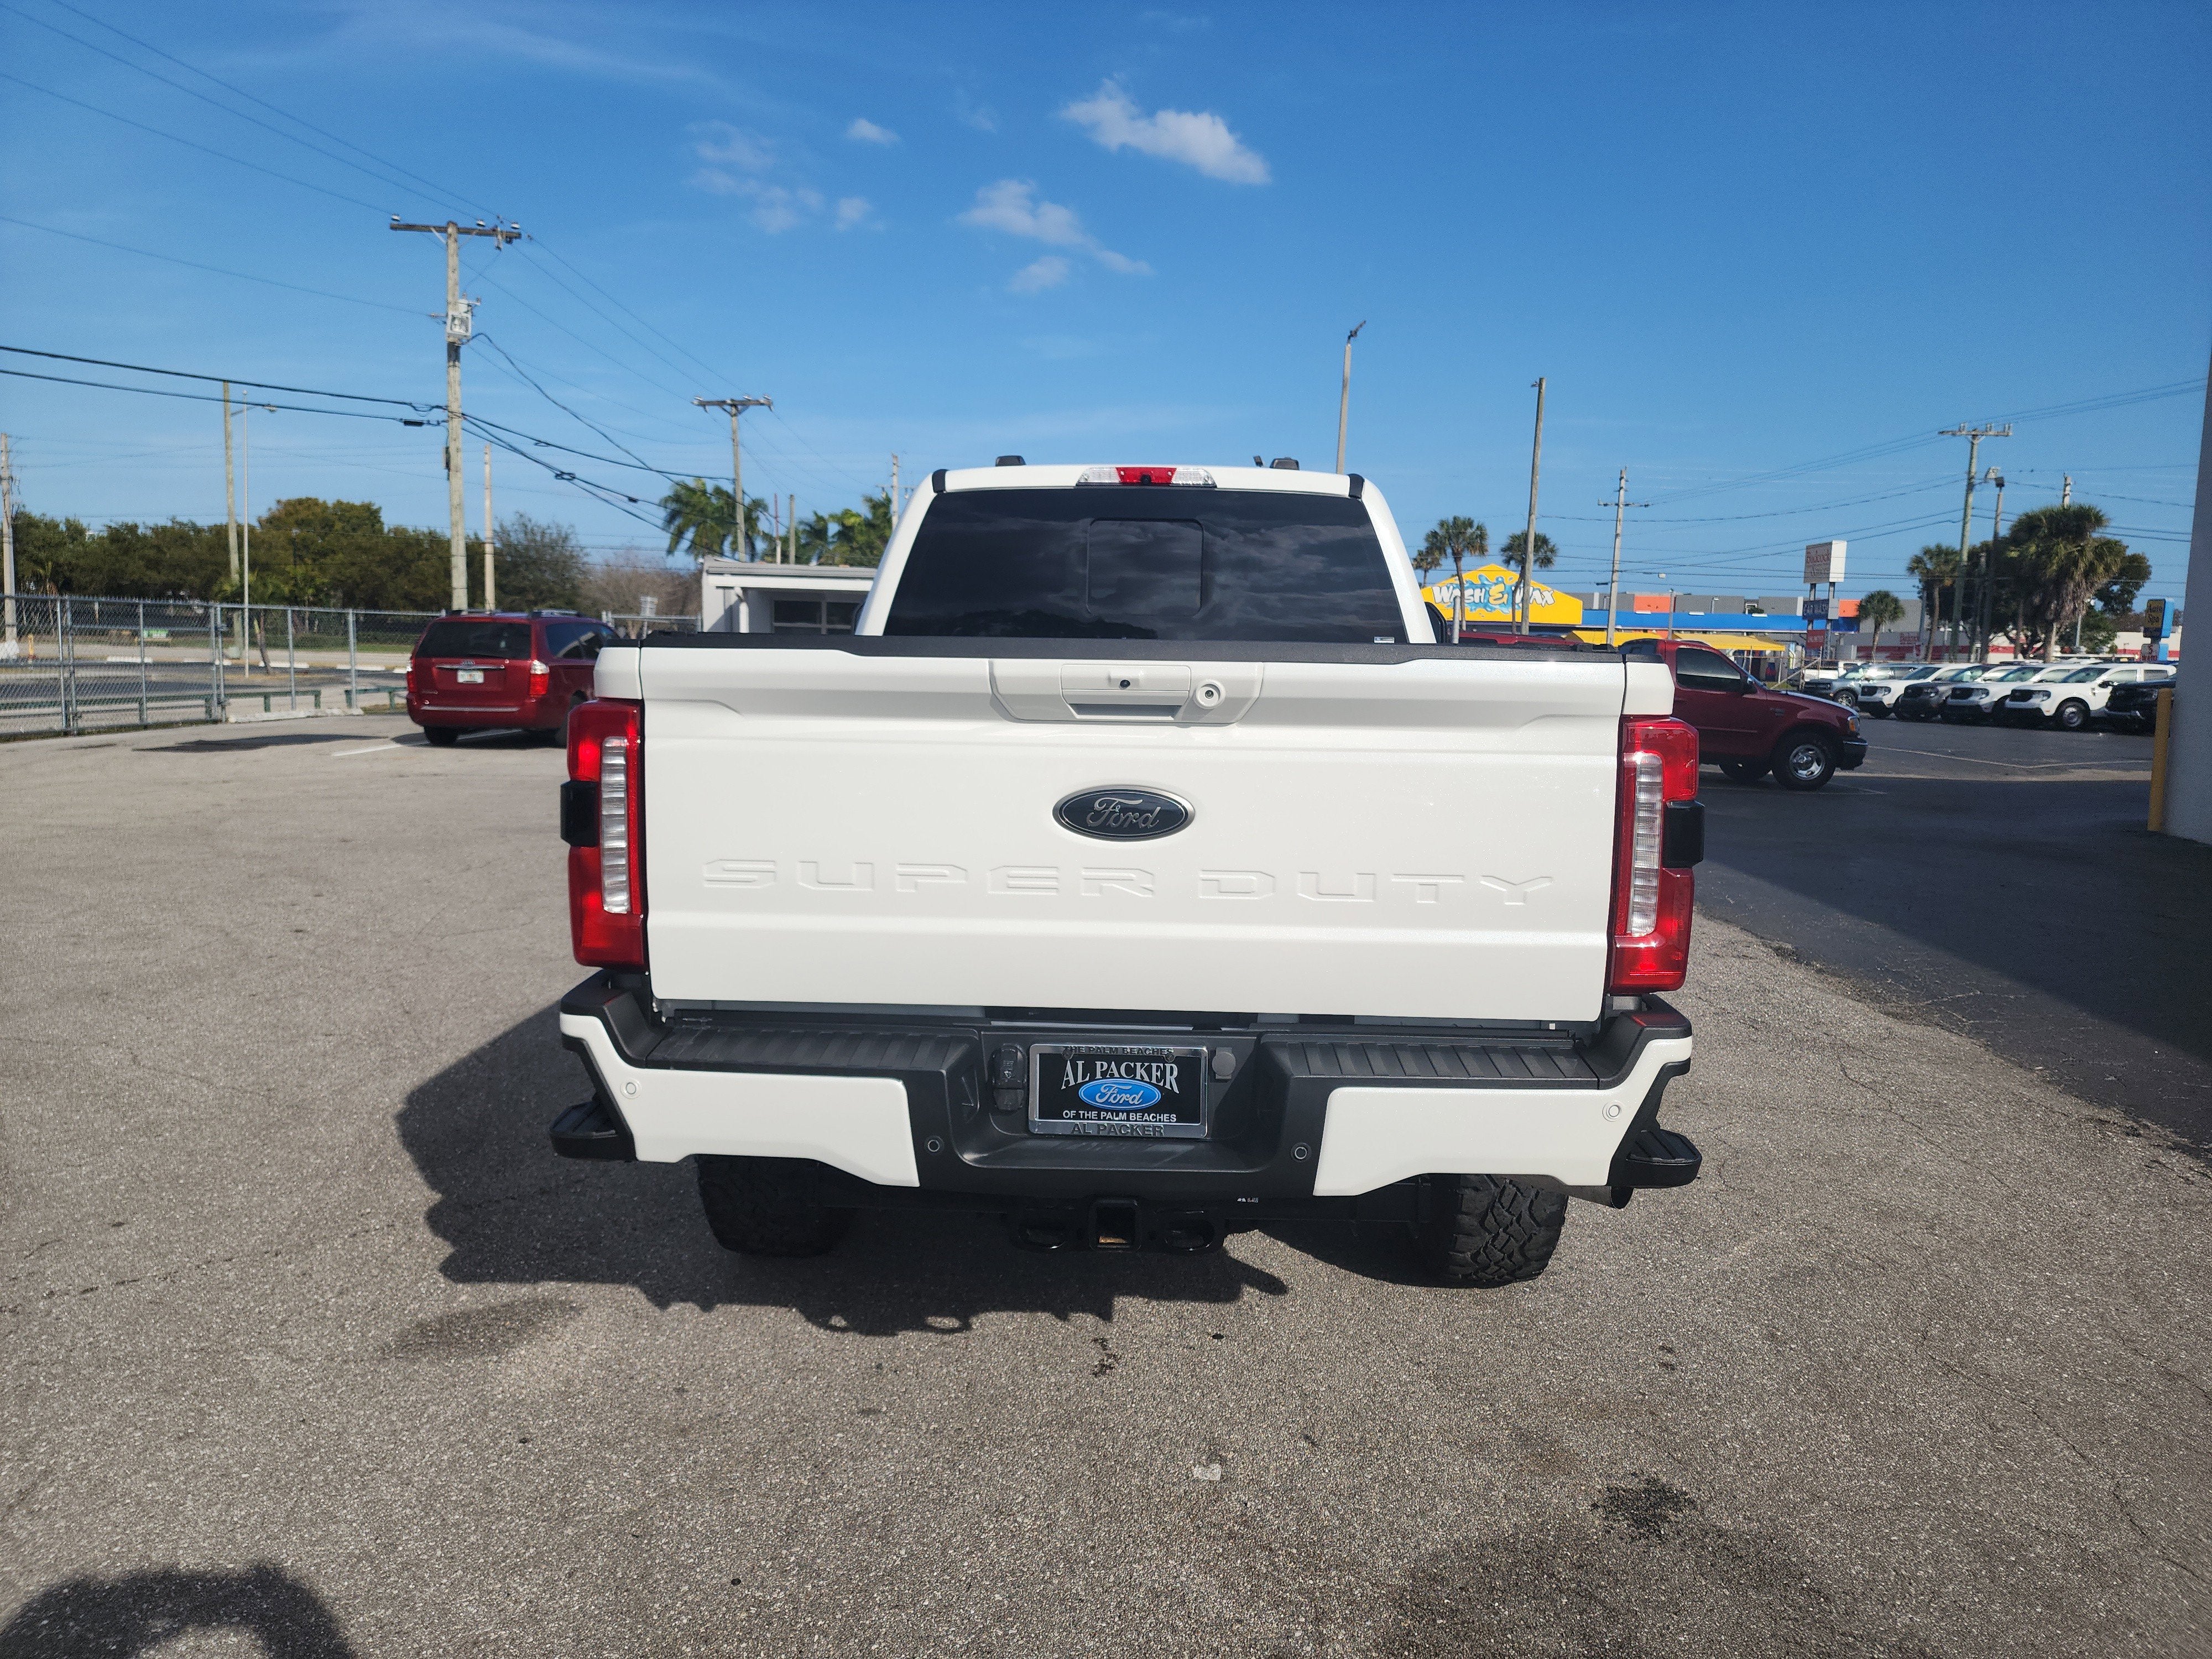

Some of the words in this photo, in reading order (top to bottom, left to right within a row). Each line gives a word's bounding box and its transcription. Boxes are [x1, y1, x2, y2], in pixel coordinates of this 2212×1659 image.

[1489, 583, 1508, 605] &
[1086, 797, 1161, 829] Ford
[703, 859, 1155, 898] SUPER
[1197, 870, 1554, 906] DUTY
[1089, 1046, 1118, 1055] PALM
[1122, 1047, 1174, 1056] BEACHES
[1061, 1060, 1090, 1091] AL
[1094, 1061, 1180, 1094] PACKER
[1095, 1084, 1144, 1105] Ford
[1062, 1110, 1077, 1119] OF
[1078, 1111, 1098, 1120] THE
[1100, 1112, 1127, 1121] PALM
[1129, 1113, 1177, 1123] BEACHES
[1070, 1123, 1093, 1135] AL
[1096, 1123, 1165, 1137] PACKER
